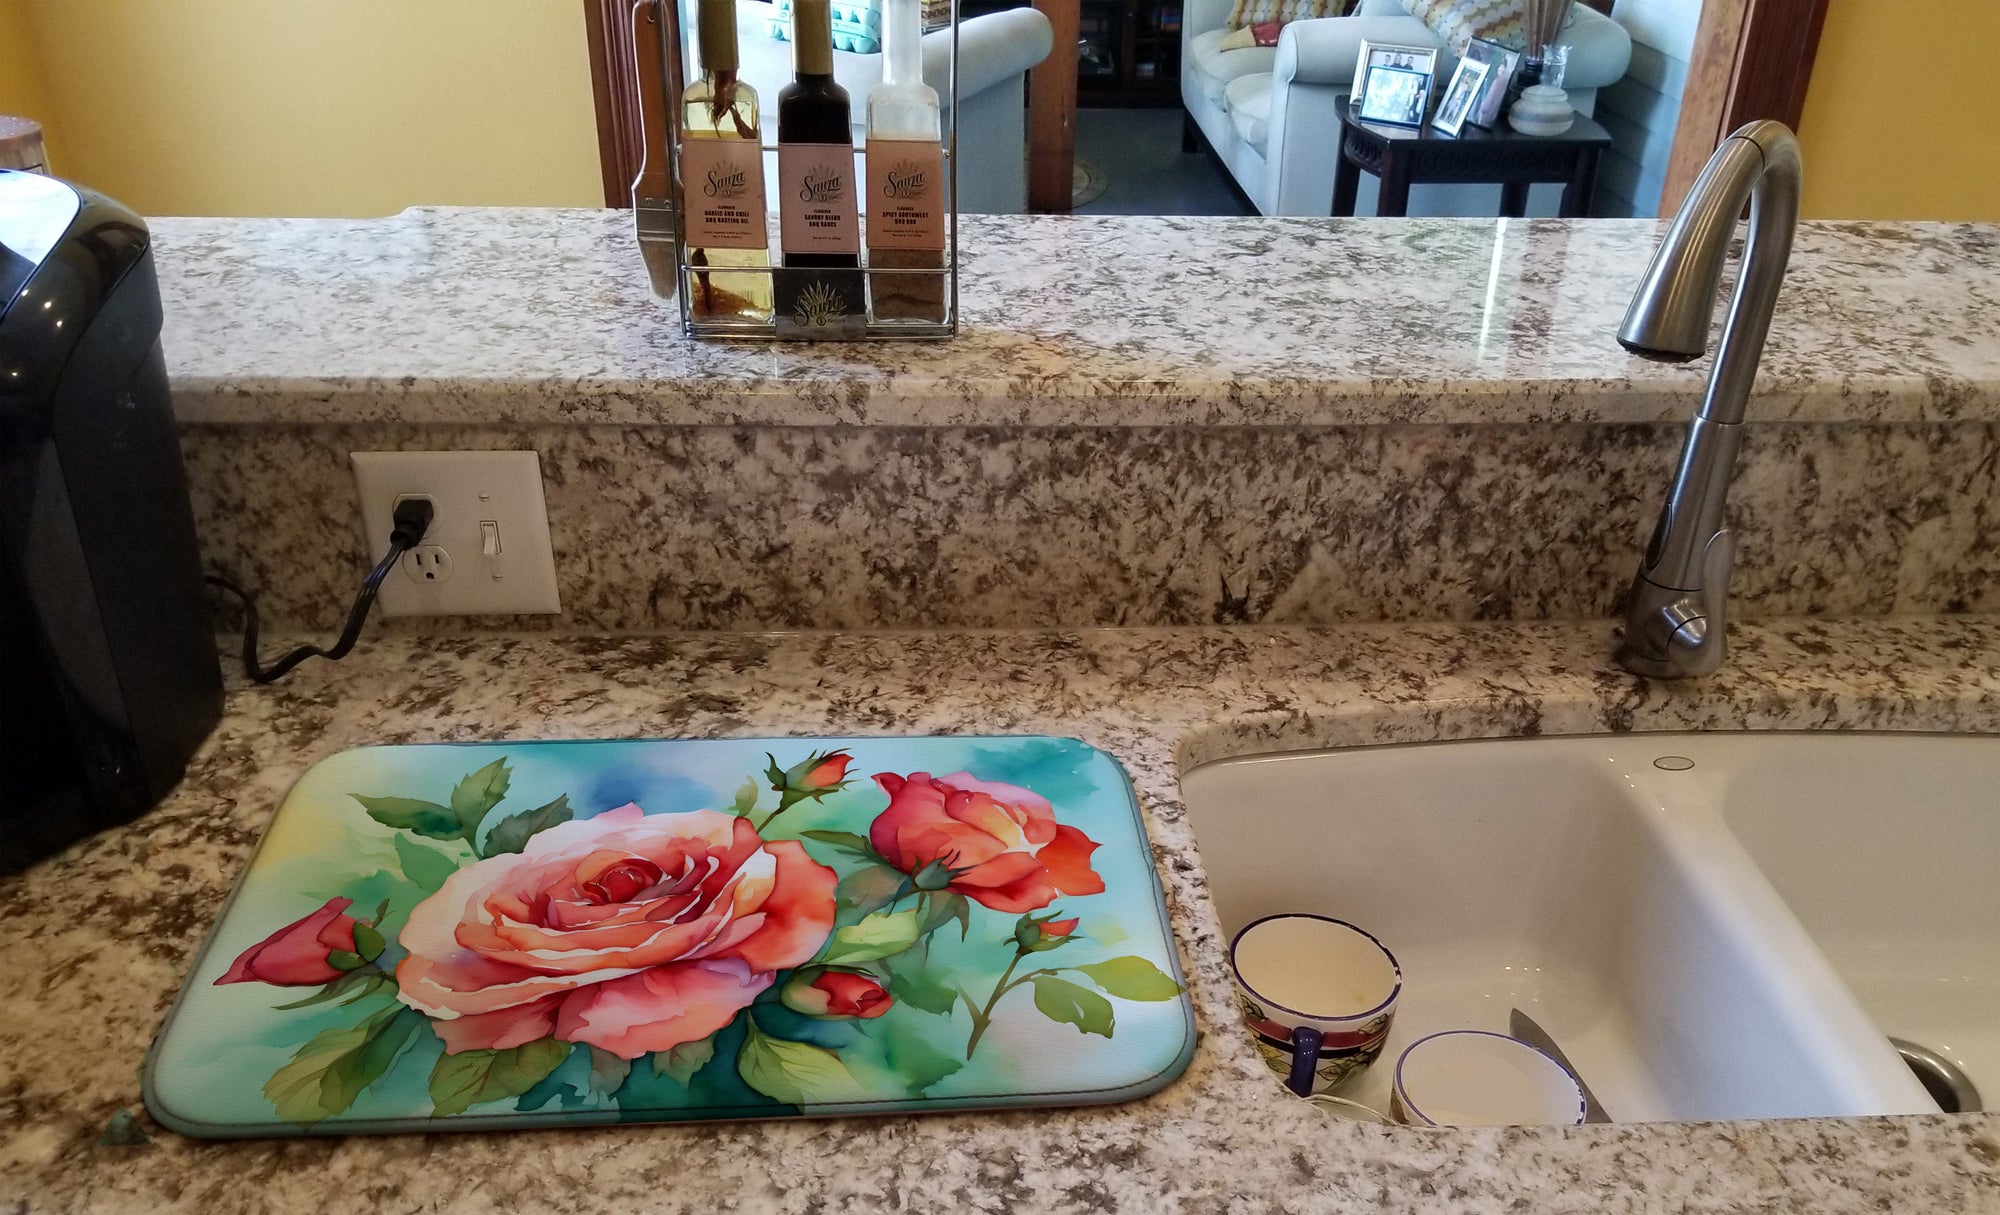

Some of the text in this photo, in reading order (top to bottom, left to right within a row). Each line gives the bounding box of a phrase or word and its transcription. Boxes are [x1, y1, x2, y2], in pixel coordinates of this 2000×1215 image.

[703, 170, 746, 198] Sauza
[799, 175, 842, 202] Sauza
[883, 171, 926, 198] Sauza
[898, 211, 929, 219] SOUTHWEST
